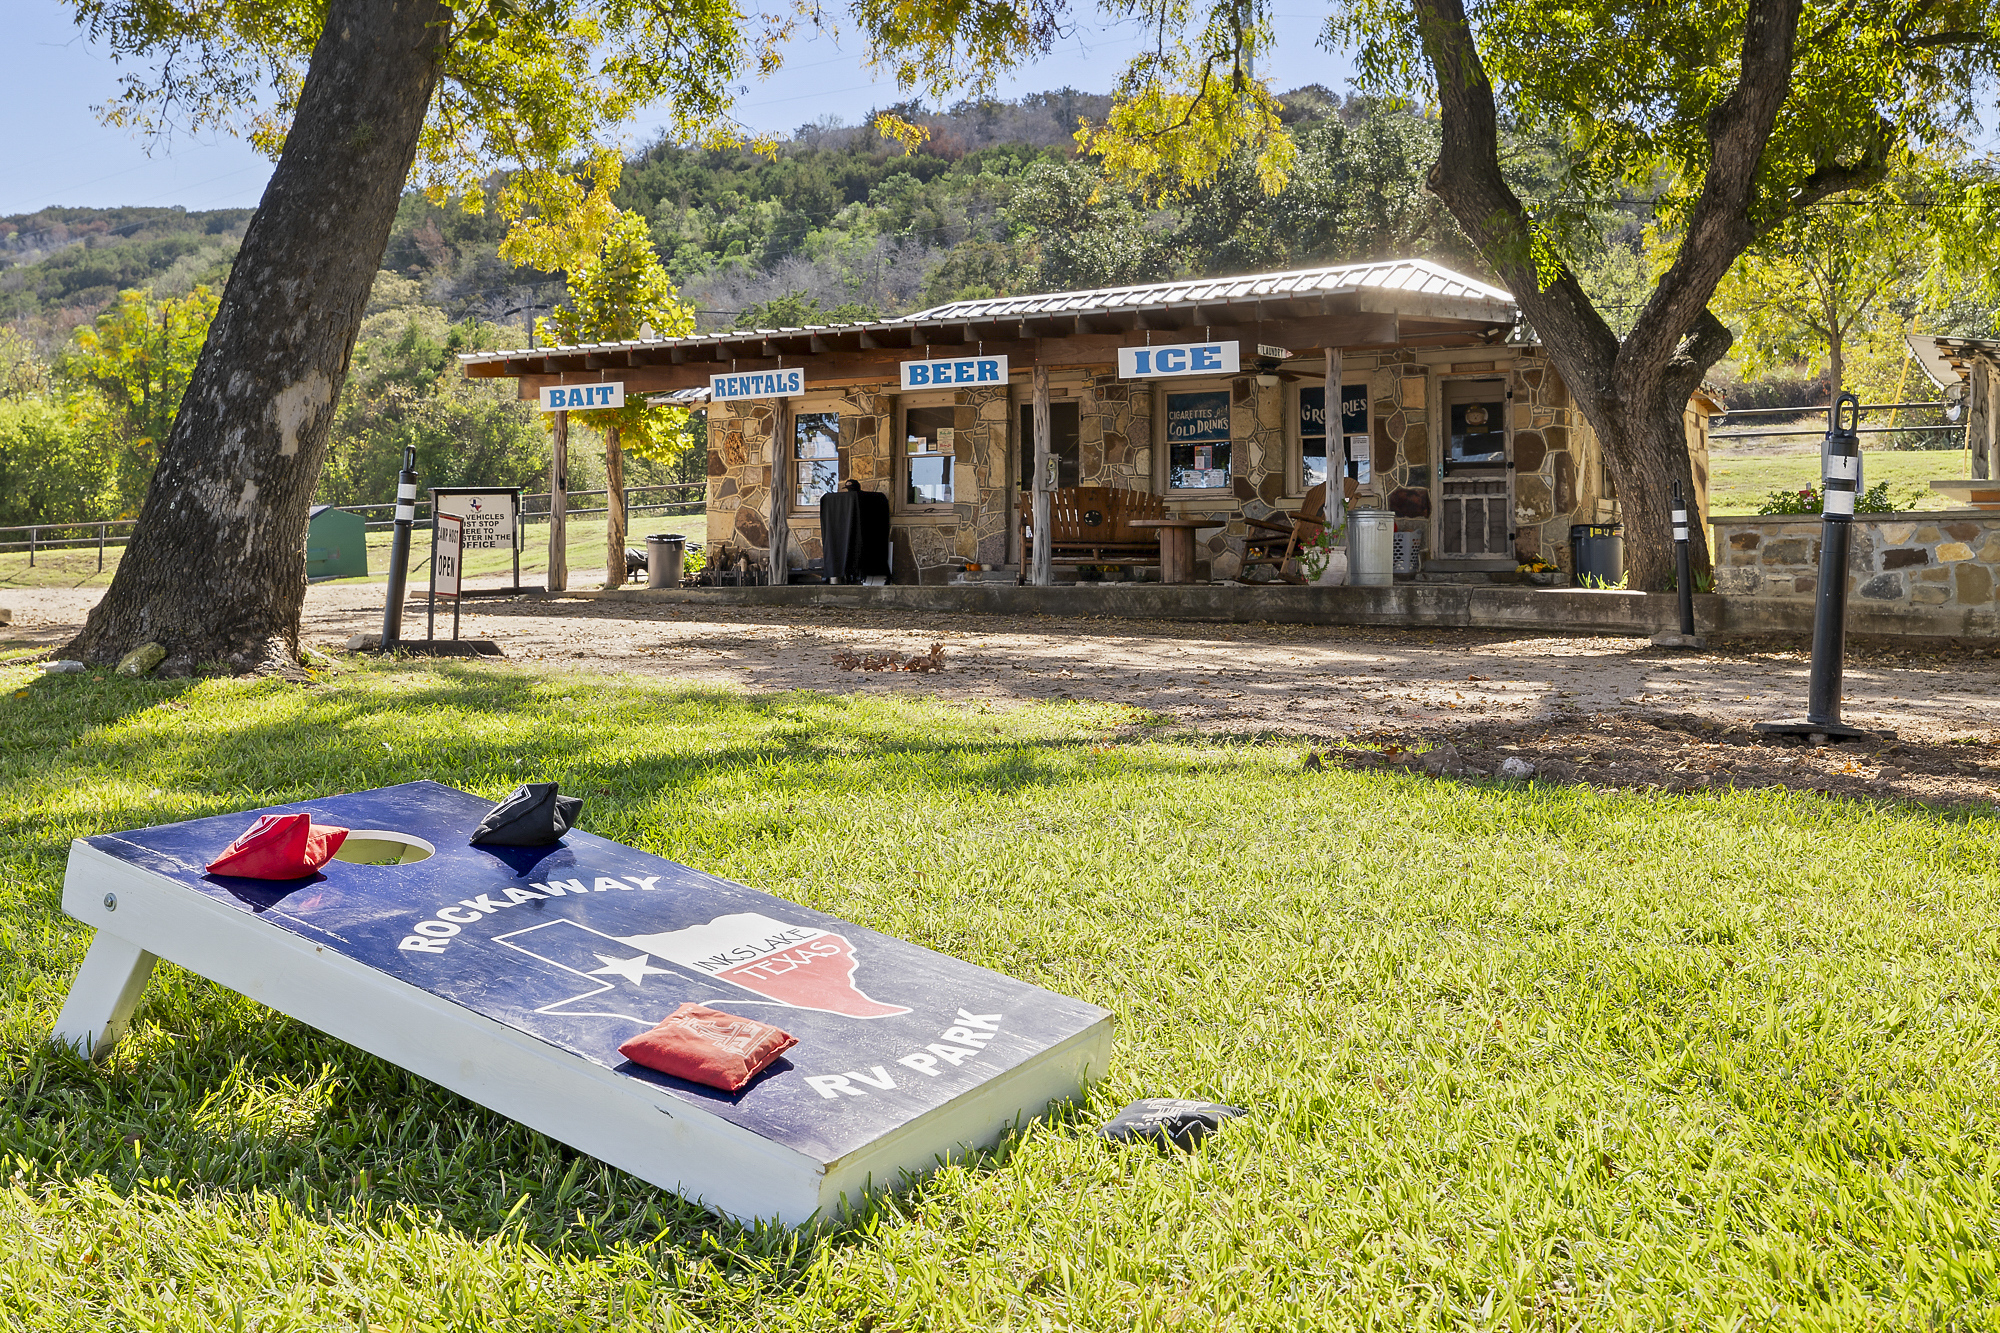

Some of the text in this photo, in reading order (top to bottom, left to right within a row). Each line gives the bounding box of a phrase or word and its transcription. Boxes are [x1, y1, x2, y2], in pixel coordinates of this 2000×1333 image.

[1134, 345, 1222, 375] ICE
[1262, 345, 1284, 358] LAUNDRY
[714, 372, 800, 398] RENTALS
[908, 359, 1000, 386] BEER
[549, 385, 614, 408] BAIT
[1168, 409, 1213, 421] CIGARETTES
[1301, 398, 1367, 424] GRORIES
[1169, 416, 1229, 437] COLD DRINKS
[449, 528, 458, 544] HOST
[438, 555, 455, 577] OPEN
[398, 875, 662, 954] ROCKAWAY
[732, 940, 842, 981] TEXAS
[803, 1007, 1004, 1100] RV PARK
